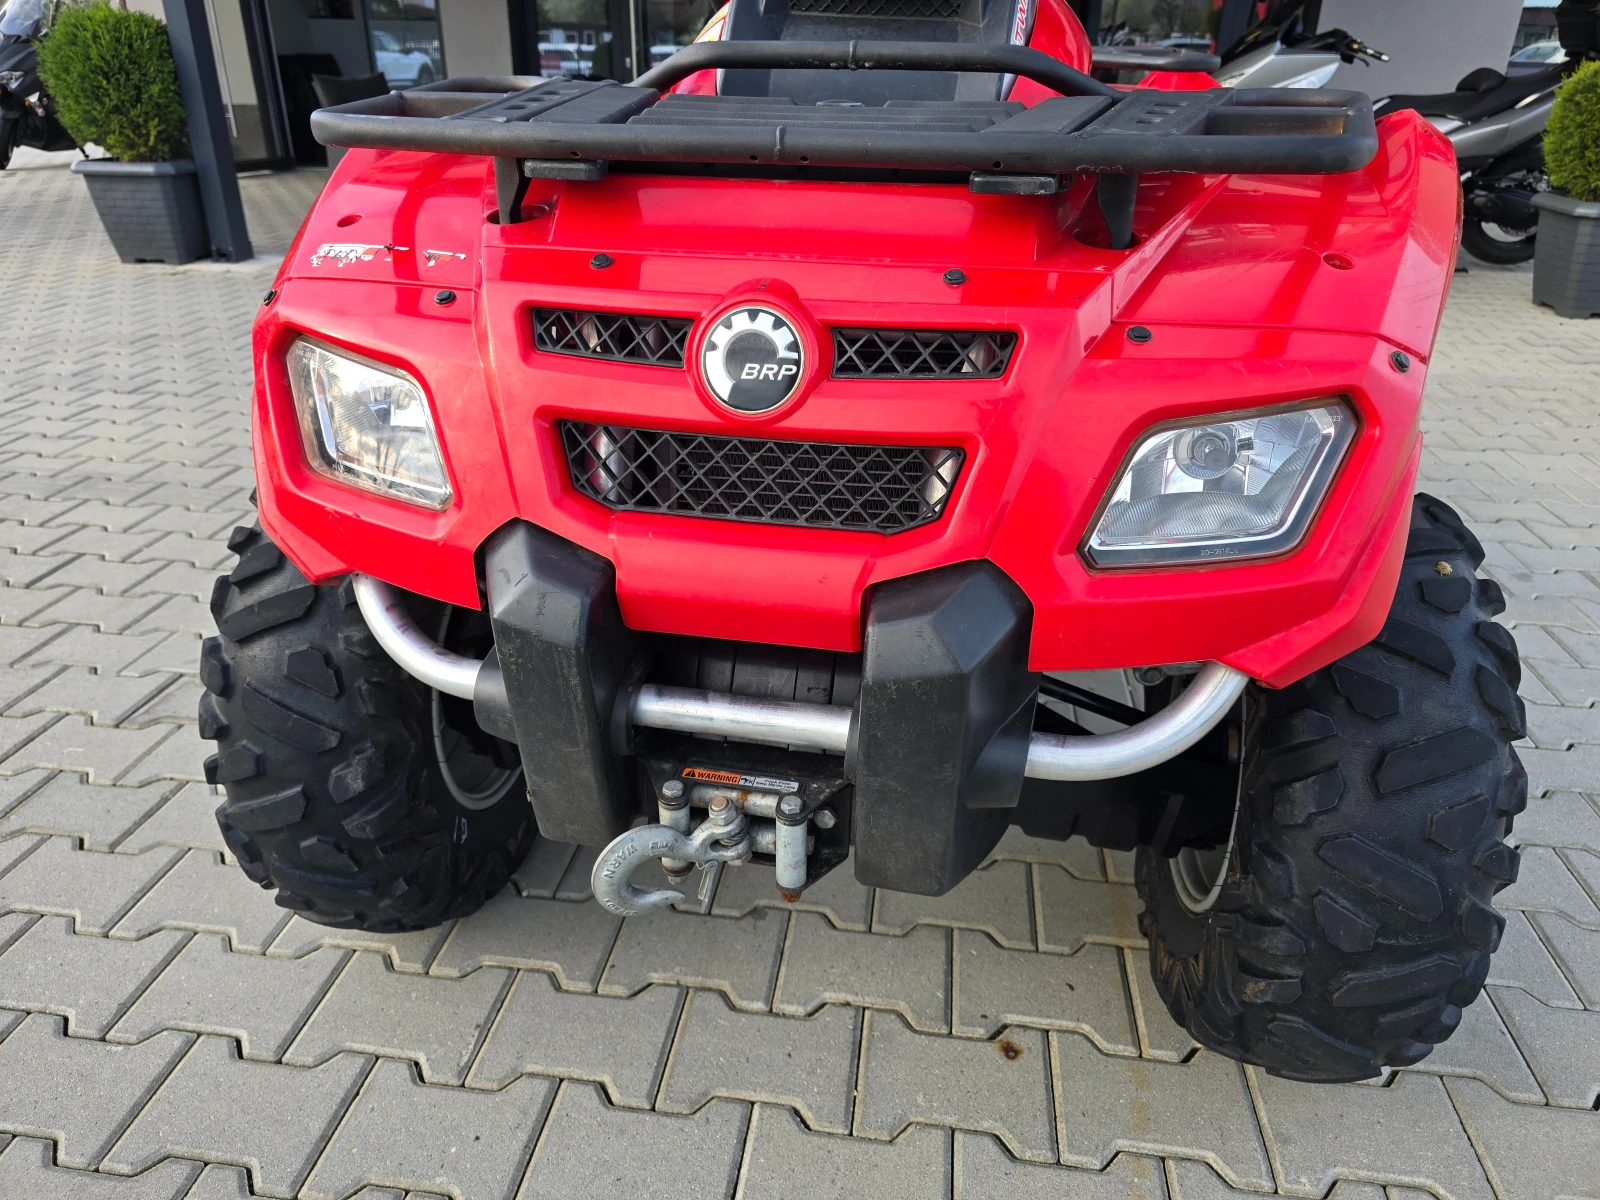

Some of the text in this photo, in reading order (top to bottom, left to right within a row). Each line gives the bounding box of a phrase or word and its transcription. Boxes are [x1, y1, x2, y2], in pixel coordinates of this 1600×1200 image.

[741, 363, 798, 381] BRP
[697, 771, 739, 784] WARNING
[603, 843, 638, 880] WARN
